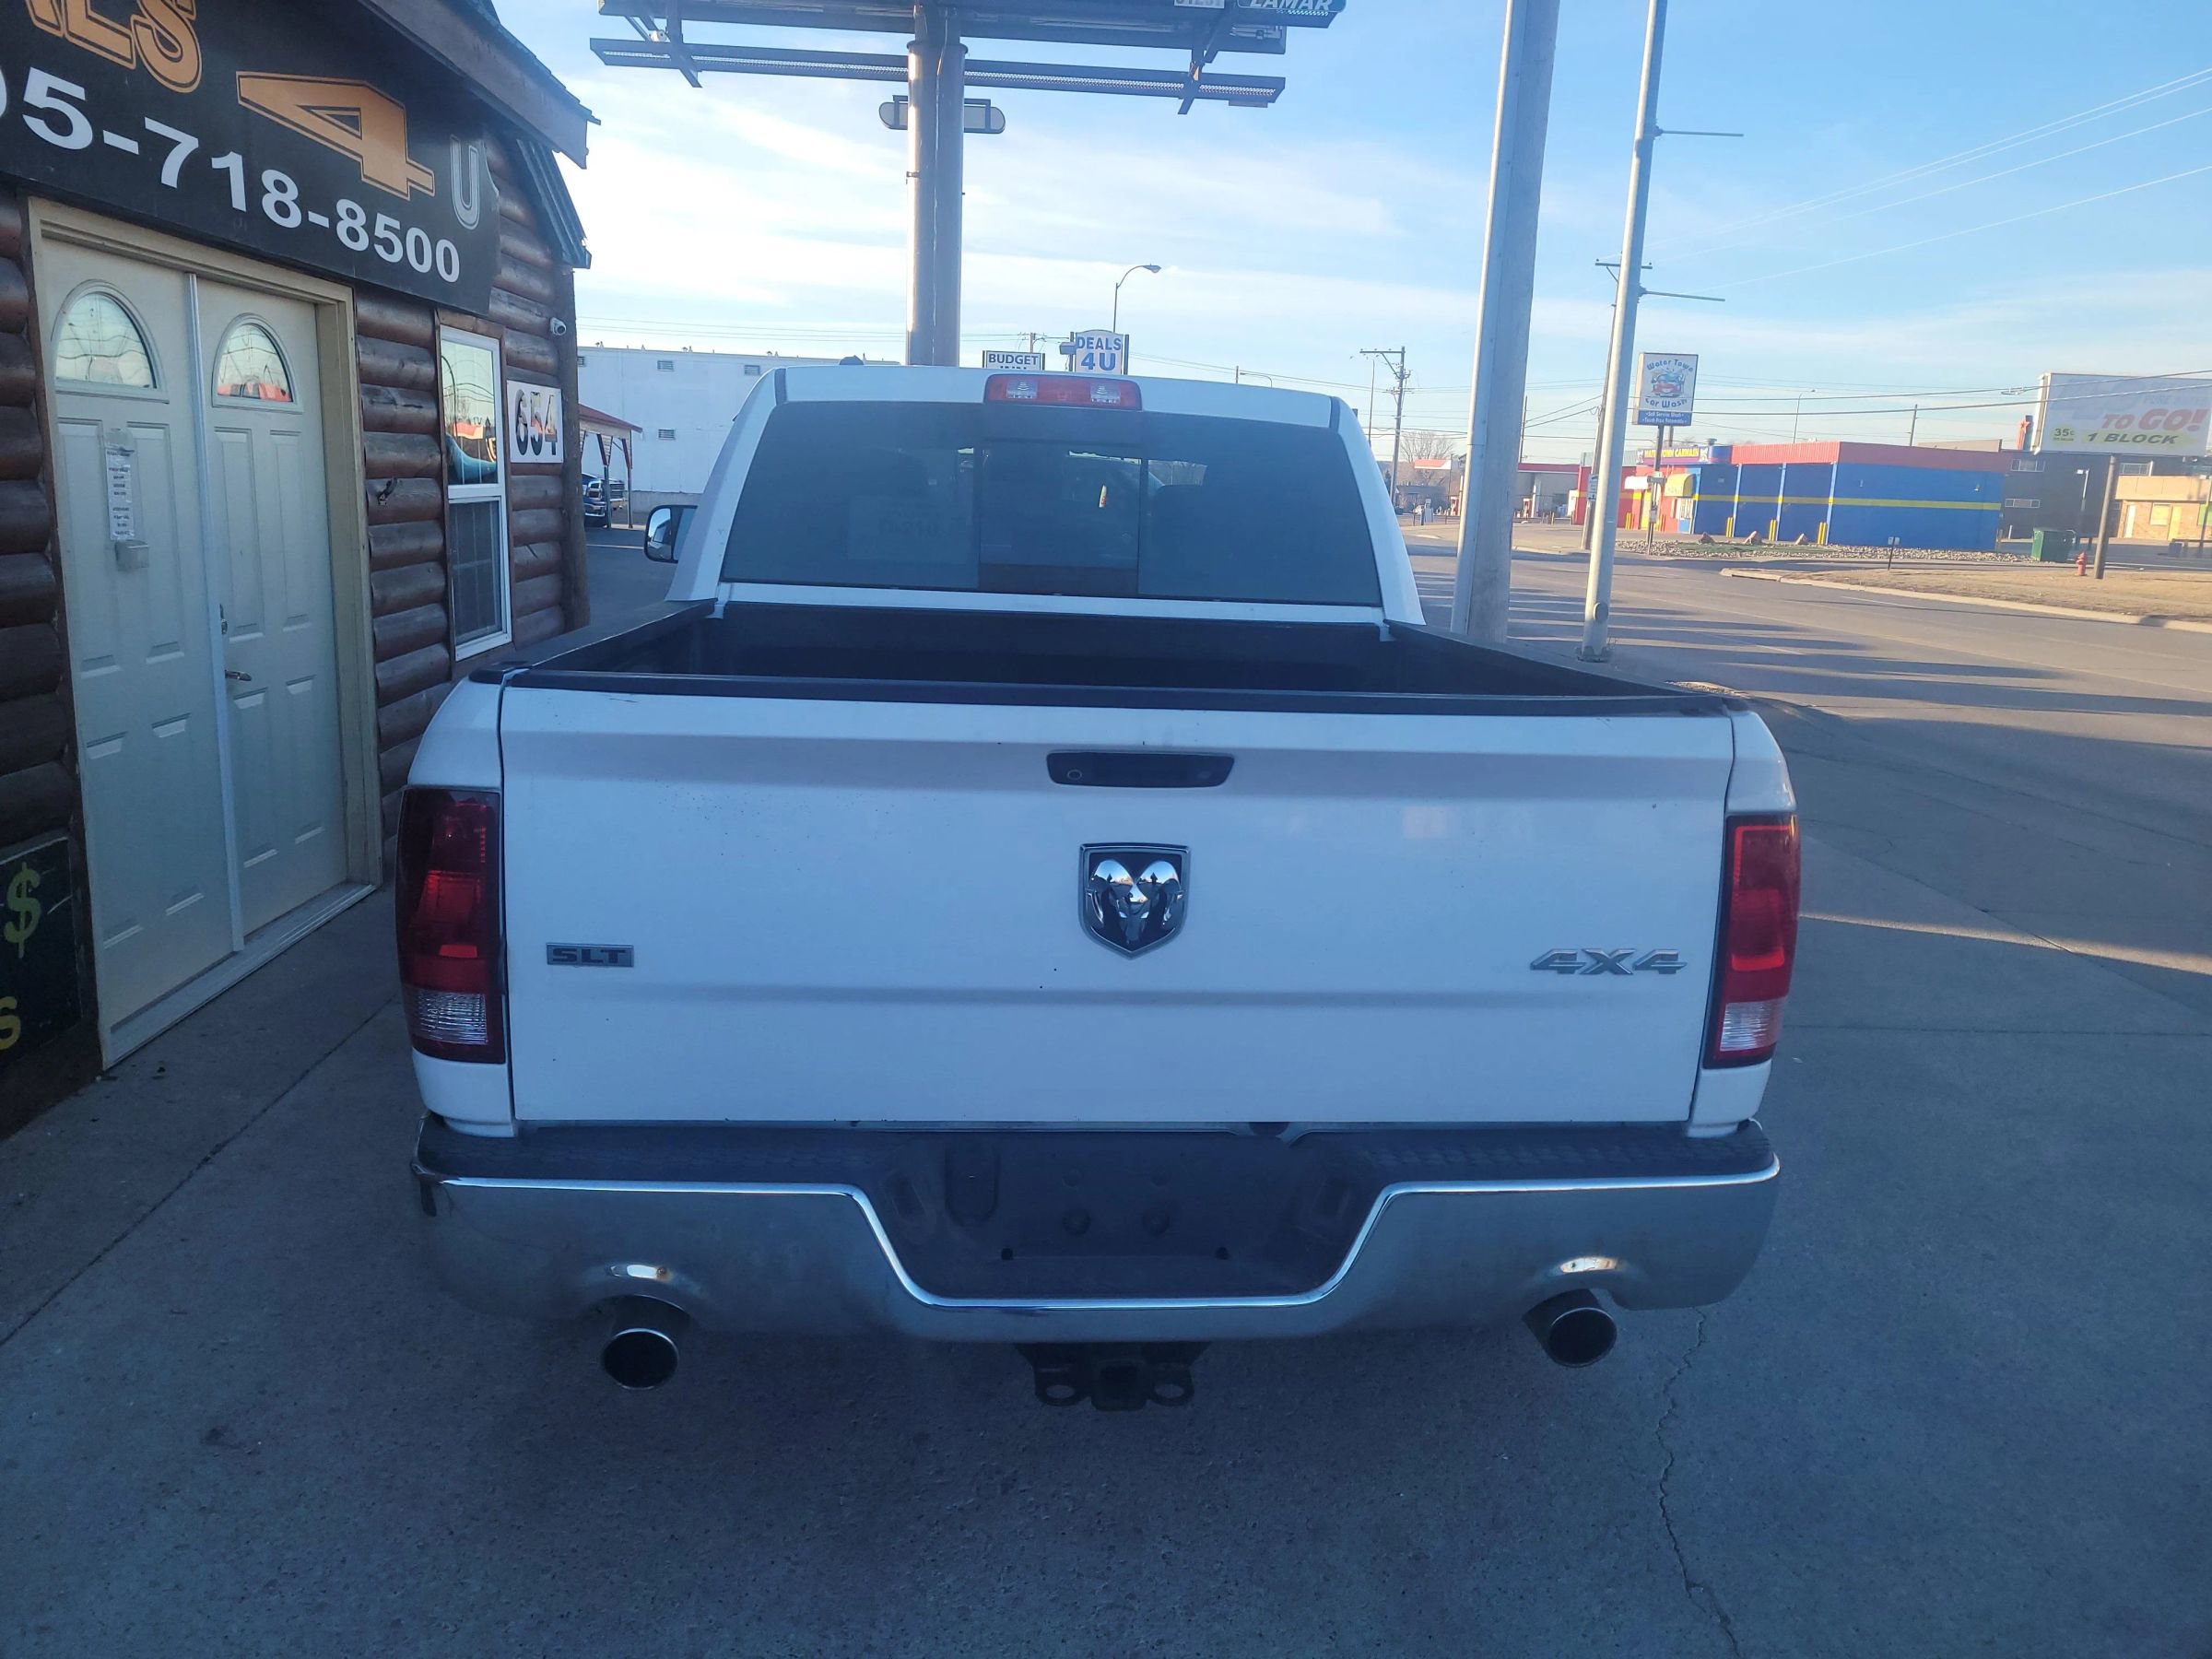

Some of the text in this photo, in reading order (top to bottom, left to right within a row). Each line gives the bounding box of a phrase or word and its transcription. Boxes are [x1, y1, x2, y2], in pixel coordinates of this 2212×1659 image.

[236, 71, 435, 201] 4
[450, 134, 479, 229] U
[0, 67, 460, 283] 5-718-8500
[1077, 336, 1122, 351] DEALS
[988, 353, 1039, 365] BUDGET
[1646, 359, 1671, 371] Water
[515, 389, 558, 455] 654
[2101, 408, 2210, 431] TO GO!
[2088, 432, 2179, 444] 1 BLOCK
[552, 947, 626, 964] SLT
[1530, 948, 1688, 975] 4X4
